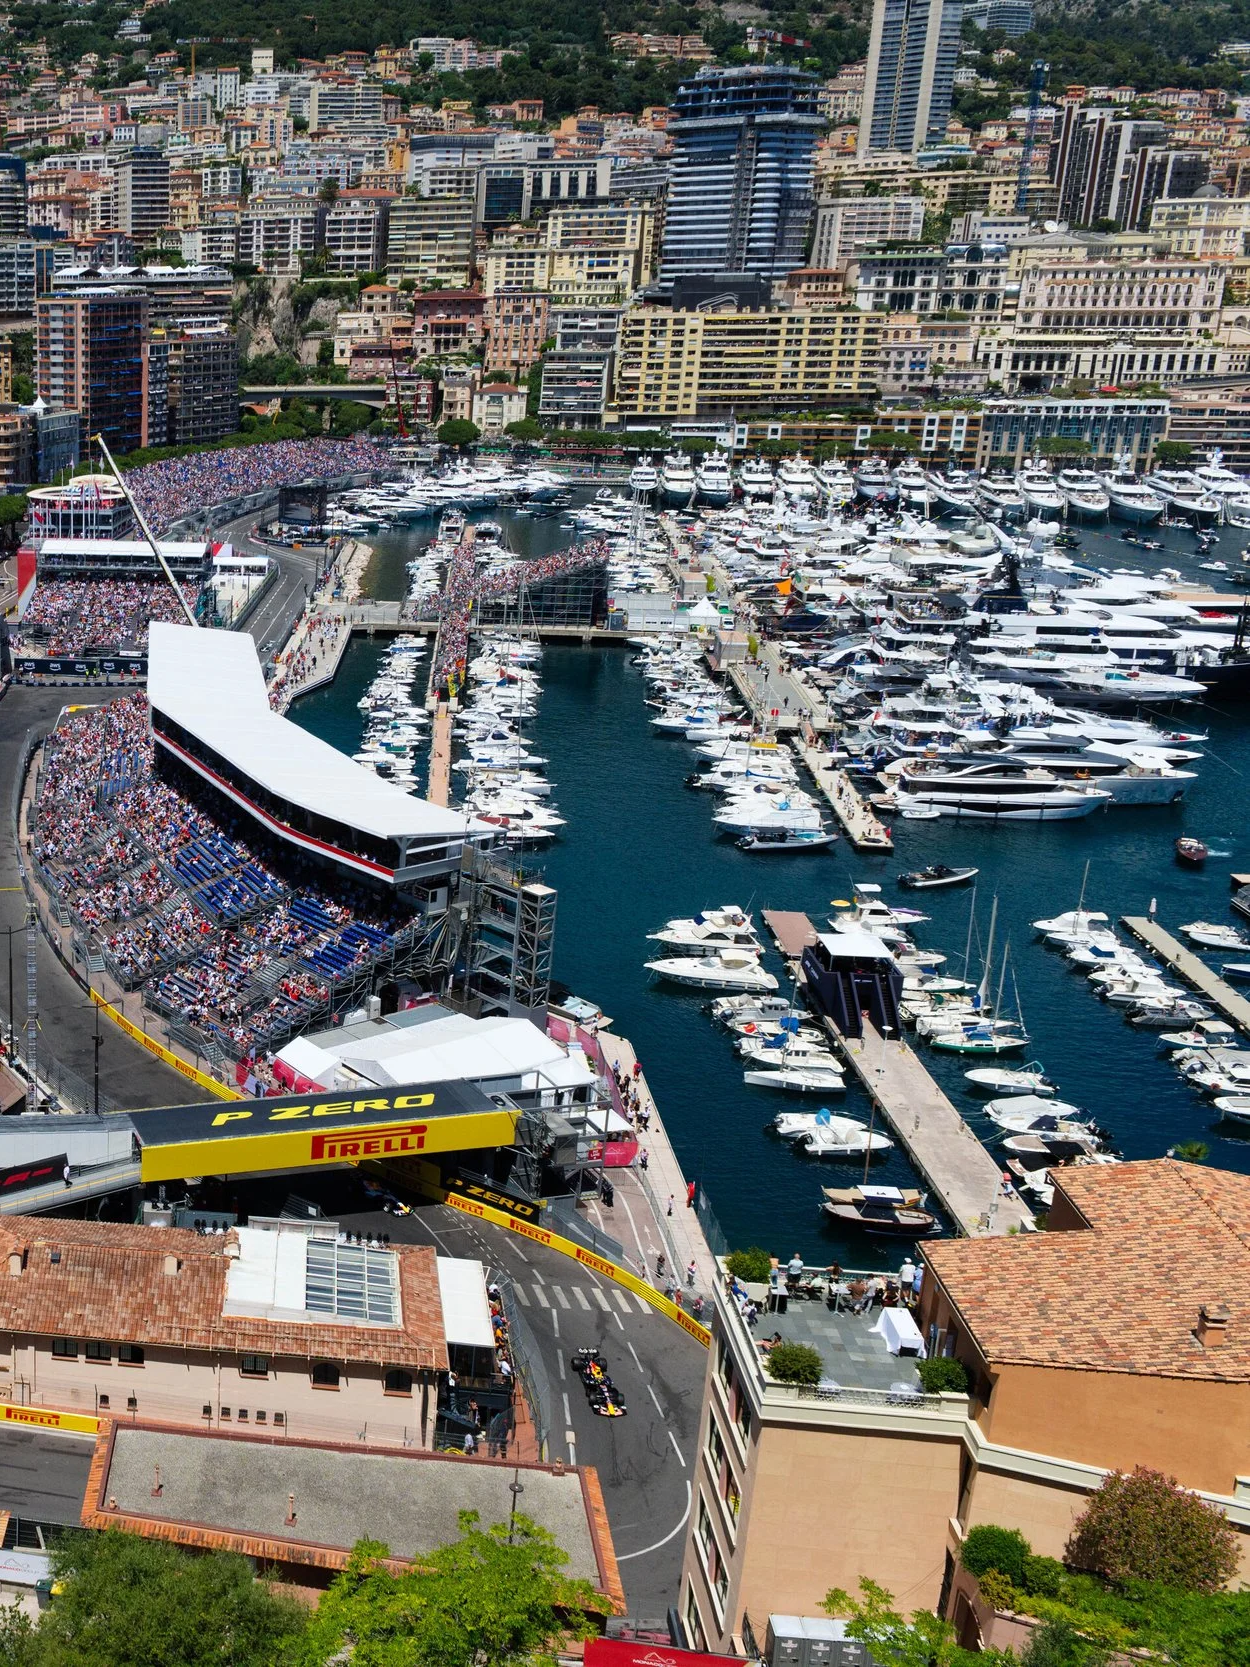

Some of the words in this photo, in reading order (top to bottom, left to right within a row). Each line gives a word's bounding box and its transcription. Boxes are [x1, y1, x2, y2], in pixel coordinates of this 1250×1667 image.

[211, 1111, 254, 1126] P
[268, 1093, 435, 1121] ZERO
[311, 1124, 427, 1160] PIRELLI
[446, 1193, 484, 1216] PIRELLI
[466, 1184, 534, 1216] ZERO
[510, 1218, 551, 1244] PIRELLI
[576, 1248, 615, 1277] PIRELLI
[677, 1311, 711, 1346] PIRELLI
[6, 1408, 60, 1426] PIRELLI
